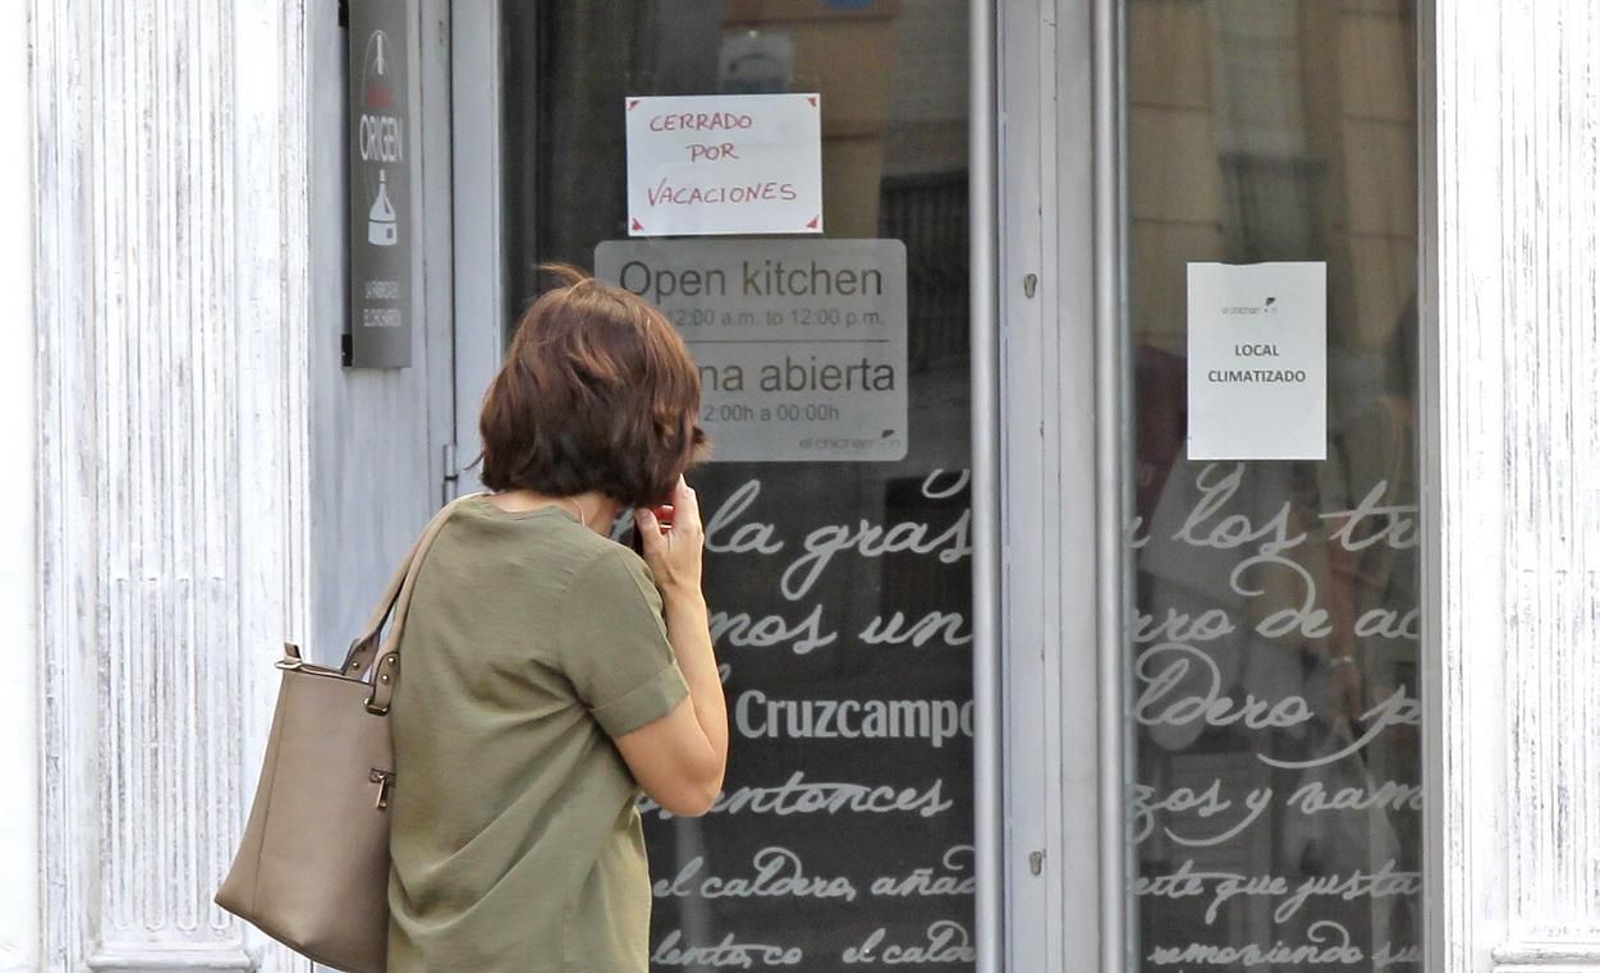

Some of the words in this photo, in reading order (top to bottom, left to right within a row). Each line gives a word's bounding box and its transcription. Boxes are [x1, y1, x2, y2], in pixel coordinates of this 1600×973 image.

[360, 113, 404, 162] ORIGEN
[649, 113, 753, 132] CERRADO
[686, 142, 739, 162] POR
[647, 177, 797, 207] VACACIONES
[620, 260, 726, 305] Open
[743, 260, 882, 297] kitchen
[766, 309, 784, 327] to
[792, 308, 840, 326] 12:00
[1234, 344, 1280, 357] LOCAL
[759, 355, 895, 393] abierta
[1208, 370, 1307, 384] CLIMATIZADO
[760, 408, 772, 422] a
[776, 403, 840, 422] 00:00h
[705, 479, 784, 553] la
[1171, 462, 1307, 557] los
[653, 856, 704, 897] el
[1204, 874, 1289, 925] que
